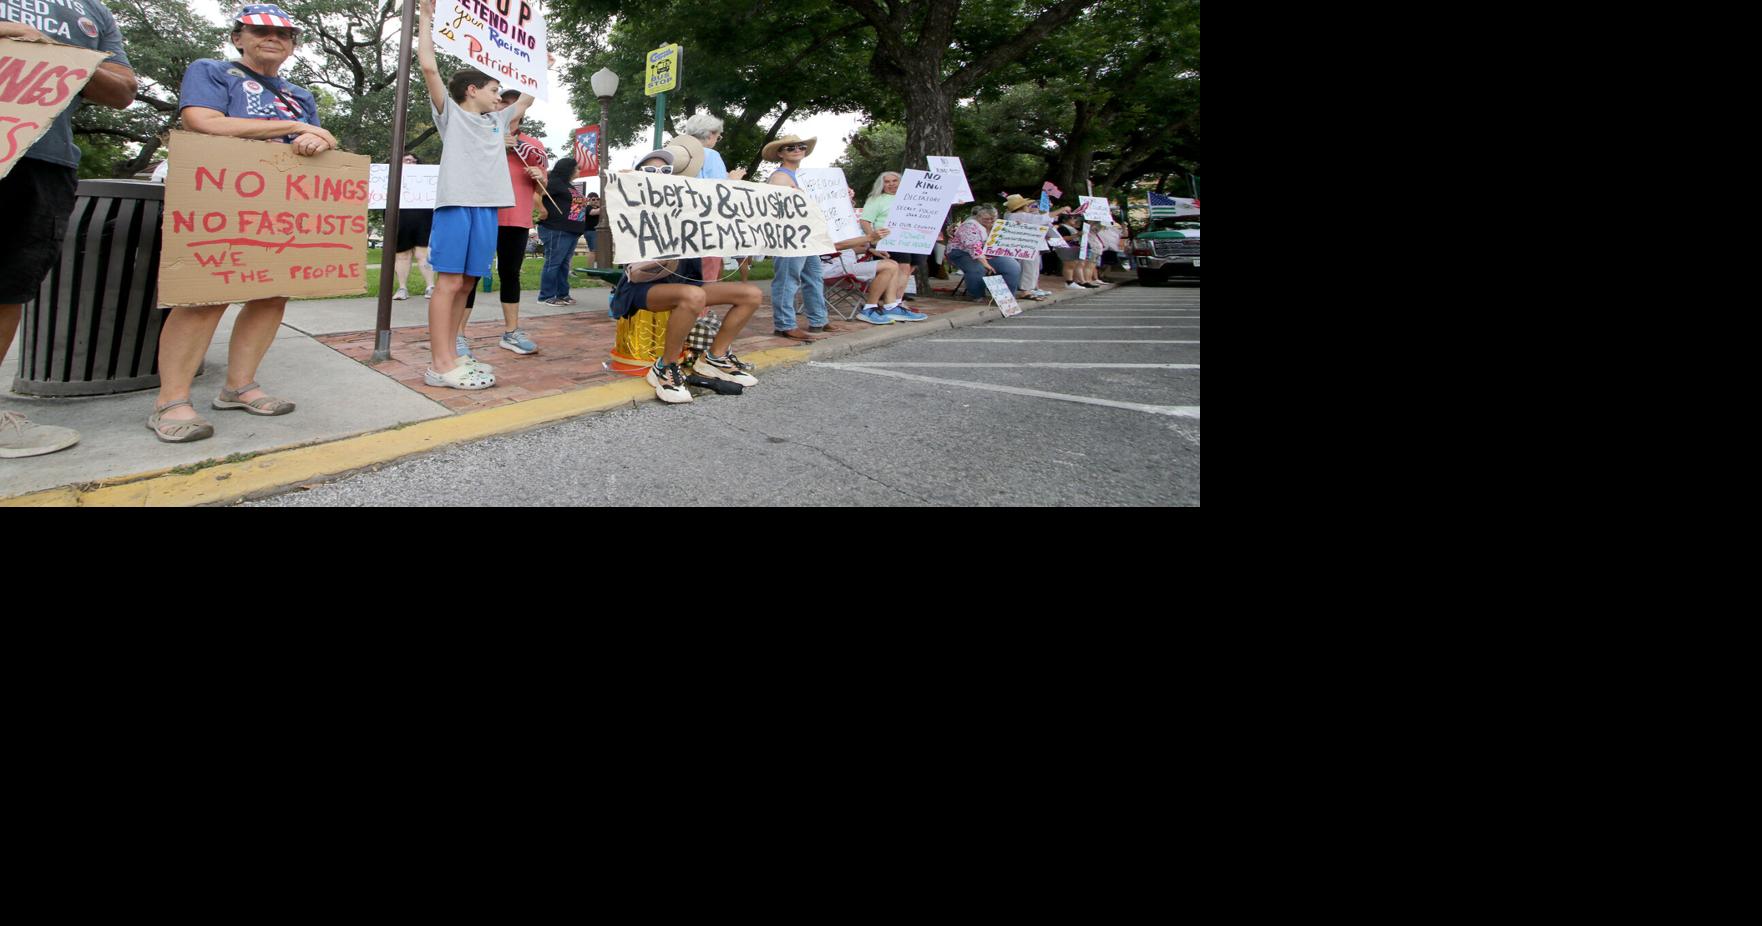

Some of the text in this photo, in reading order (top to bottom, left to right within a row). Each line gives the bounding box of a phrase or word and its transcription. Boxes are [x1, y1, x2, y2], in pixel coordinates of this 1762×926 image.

[459, 0, 537, 50] ETENDING
[484, 0, 532, 27] OP
[487, 27, 531, 63] Racism
[463, 34, 539, 89] Patriotism
[647, 76, 673, 89] STOP
[651, 73, 670, 82] BUS
[195, 166, 368, 202] NO KINGS
[923, 172, 941, 181] NO
[715, 183, 741, 219] &
[732, 186, 808, 219] Justice
[173, 210, 366, 236] NO FASCISTS
[680, 218, 812, 255] REMEMBER?
[193, 251, 246, 268] WE
[211, 263, 360, 285] THE PEOPLE
